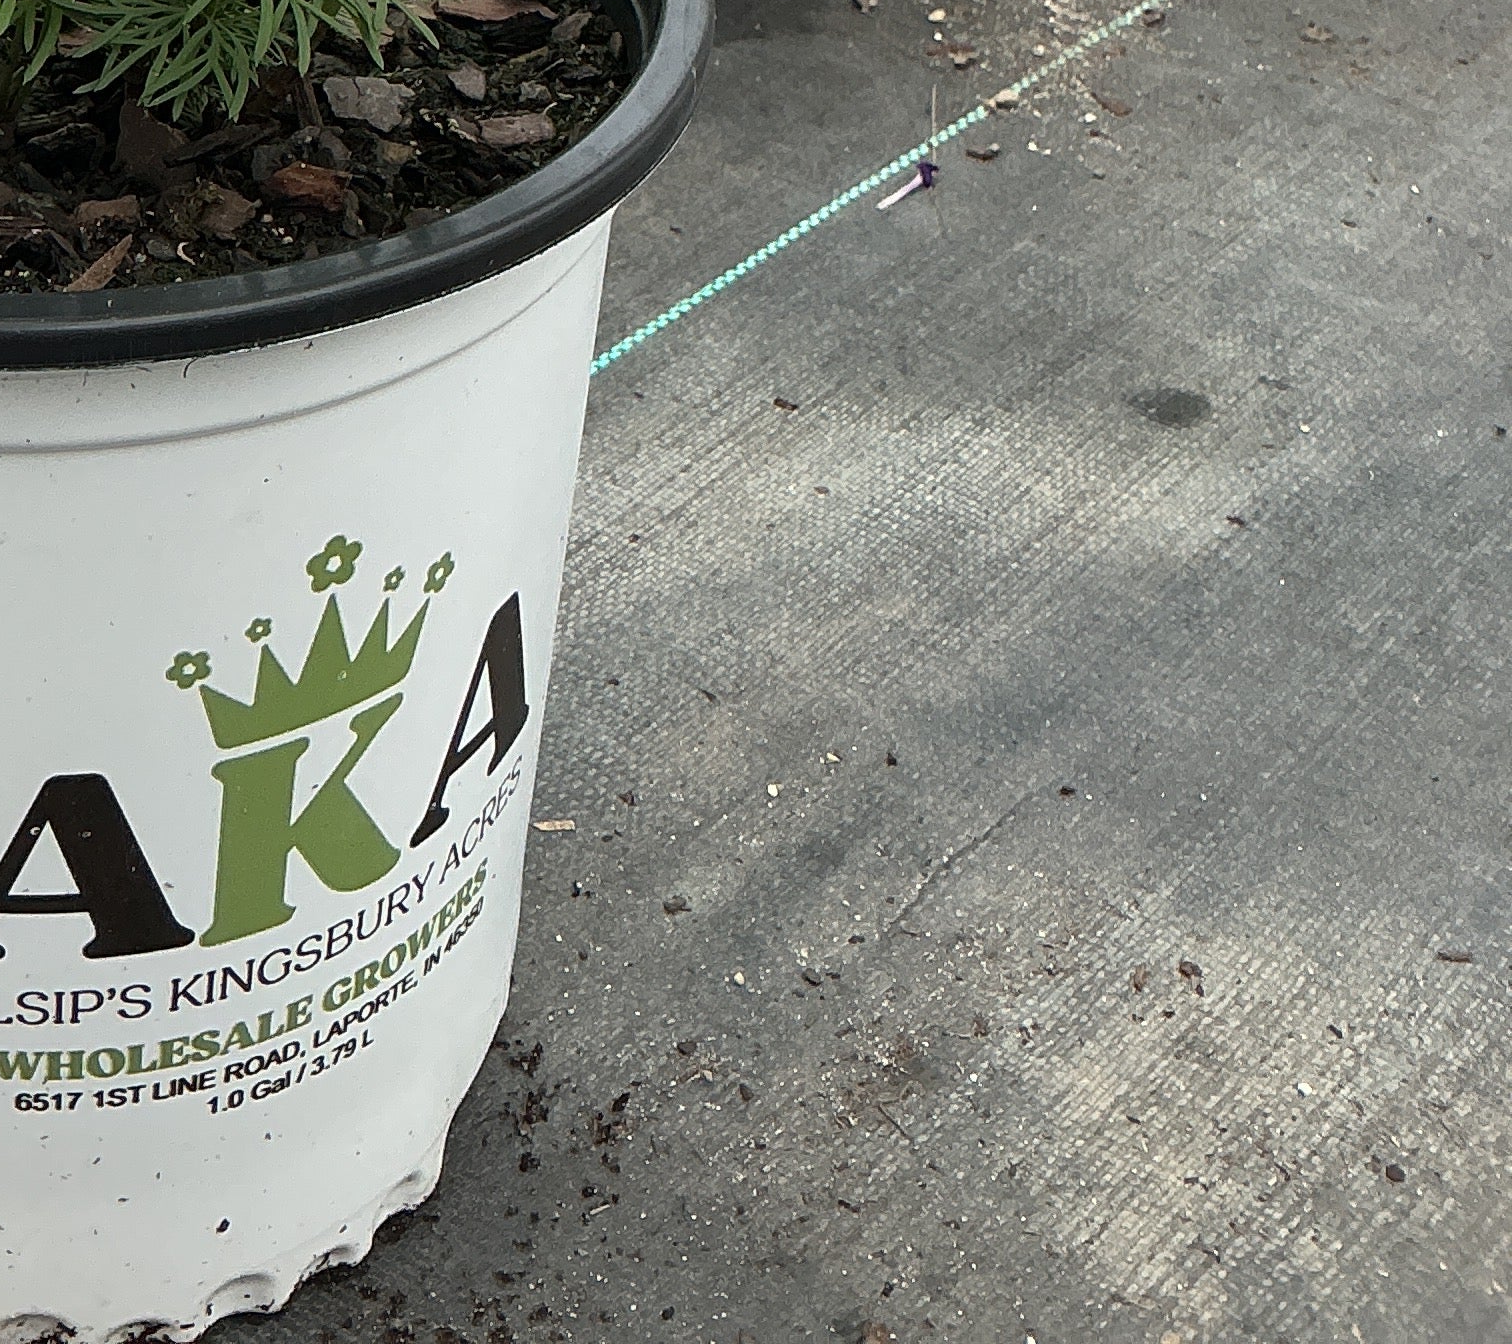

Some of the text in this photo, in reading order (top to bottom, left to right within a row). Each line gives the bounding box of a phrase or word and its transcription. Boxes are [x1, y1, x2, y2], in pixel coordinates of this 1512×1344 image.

[169, 861, 435, 1012] KINGSBURY
[439, 755, 522, 884] ACRES
[321, 857, 488, 1012] GROWERS
[14, 1091, 83, 1112] 6517
[93, 1084, 146, 1108] 1ST
[152, 1069, 216, 1100] LINE
[313, 970, 418, 1048] LAPORTE,
[423, 945, 442, 976] IN
[444, 895, 484, 953] 46350
[207, 1089, 244, 1114] 1.0
[250, 1069, 291, 1100] Gal
[310, 1038, 357, 1076] 3.79
[361, 1029, 374, 1048] L
